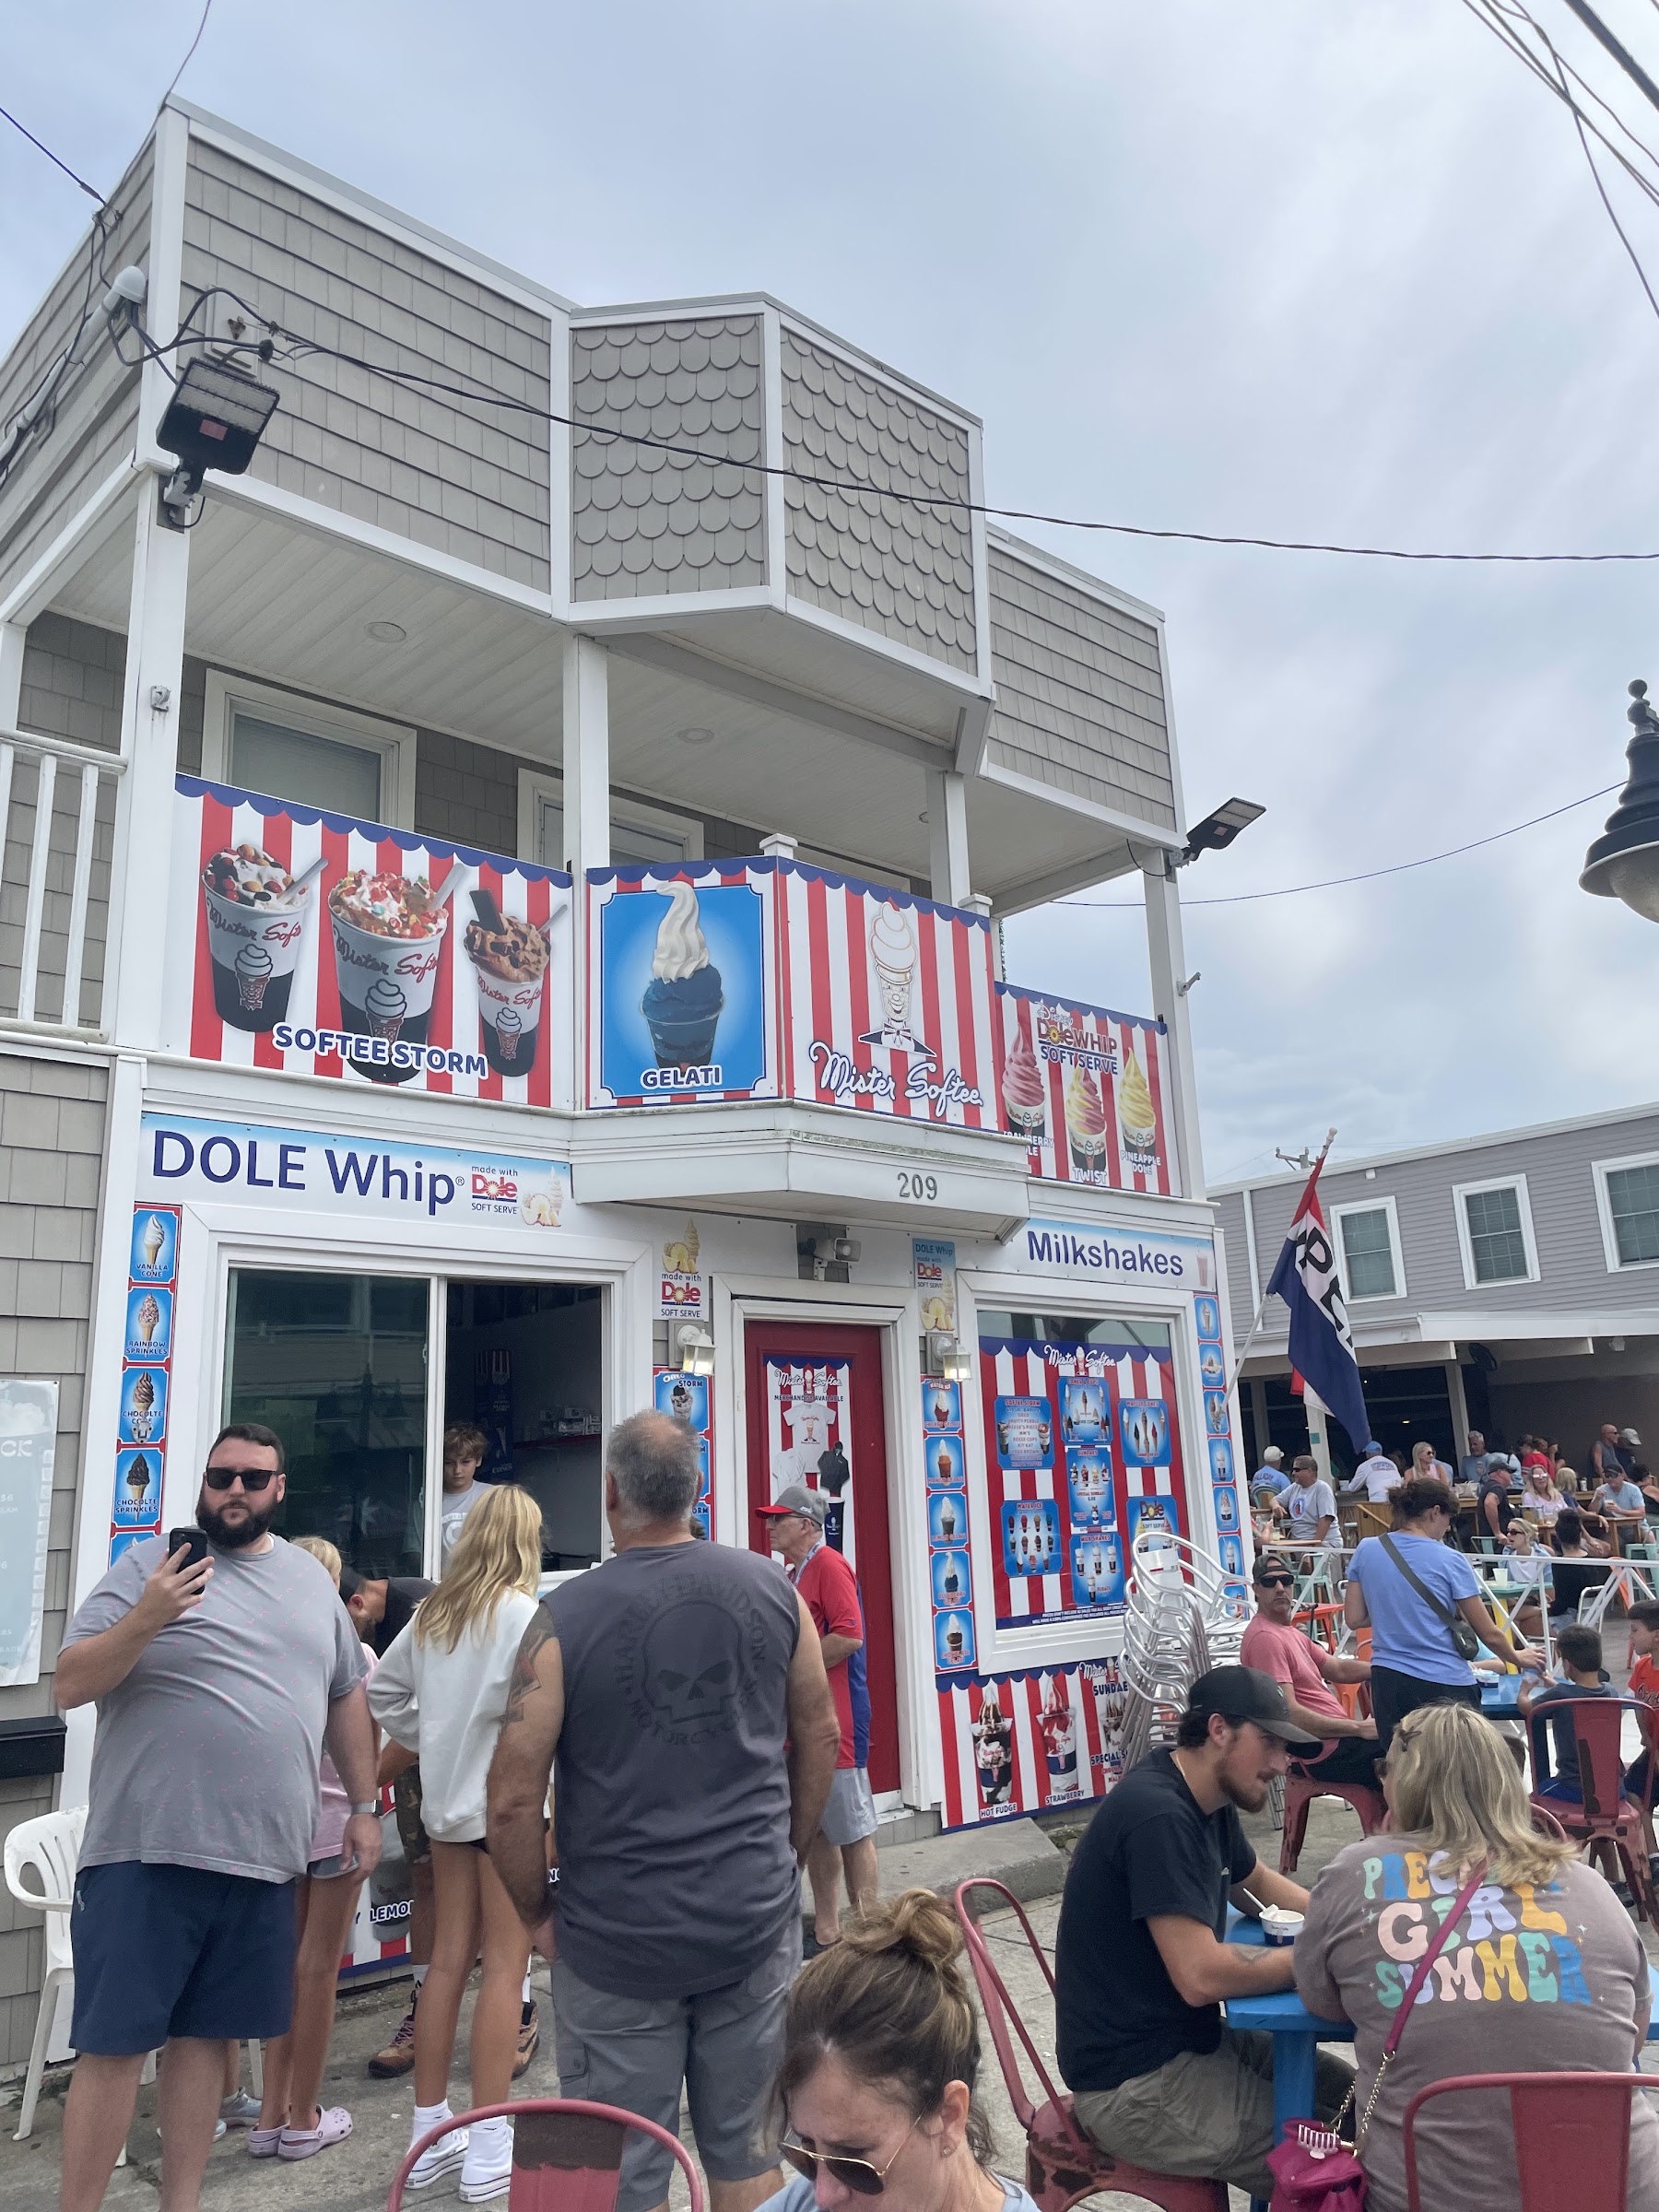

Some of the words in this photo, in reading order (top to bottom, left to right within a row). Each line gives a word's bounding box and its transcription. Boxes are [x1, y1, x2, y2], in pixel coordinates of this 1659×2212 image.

[276, 1026, 387, 1064] SOFTEE
[396, 1042, 487, 1078] STORM
[1041, 1045, 1075, 1066] SOFT
[1078, 1053, 1118, 1076] SERVE
[642, 1066, 721, 1088] GELATI
[808, 1041, 896, 1100] Mister
[905, 1062, 983, 1117] Softee
[153, 1130, 307, 1191] DOLE
[1121, 1150, 1161, 1166] PINEAPPLE
[472, 1166, 497, 1175] made
[499, 1168, 518, 1177] with
[1073, 1166, 1107, 1184] TWIST
[1132, 1164, 1152, 1174] DOLE
[472, 1174, 518, 1199] Dole
[897, 1172, 937, 1200] 209
[471, 1203, 491, 1213] SOFT
[493, 1205, 518, 1215] SERVE
[916, 1244, 934, 1253] DOLE
[935, 1246, 953, 1256] Whip
[1028, 1230, 1184, 1277] Milkshakes
[662, 1272, 683, 1280] made
[685, 1273, 701, 1282] with
[917, 1263, 942, 1278] Dole
[662, 1281, 701, 1304] Dole
[661, 1309, 678, 1318] SOFT
[680, 1309, 700, 1318] SERVE
[1043, 1345, 1077, 1366] Mister
[1085, 1349, 1116, 1373] Softee
[1140, 1500, 1164, 1519] Dole
[1090, 1751, 1120, 1765] SPECIAL
[1045, 1790, 1085, 1804] STRAWBERRY
[981, 1807, 994, 1818] HOT
[995, 1804, 1017, 1815] FUDGE
[370, 1901, 413, 1923] LEMO
[1378, 1886, 1567, 1961] GIRL
[1375, 1933, 1592, 2008] SUMMER
